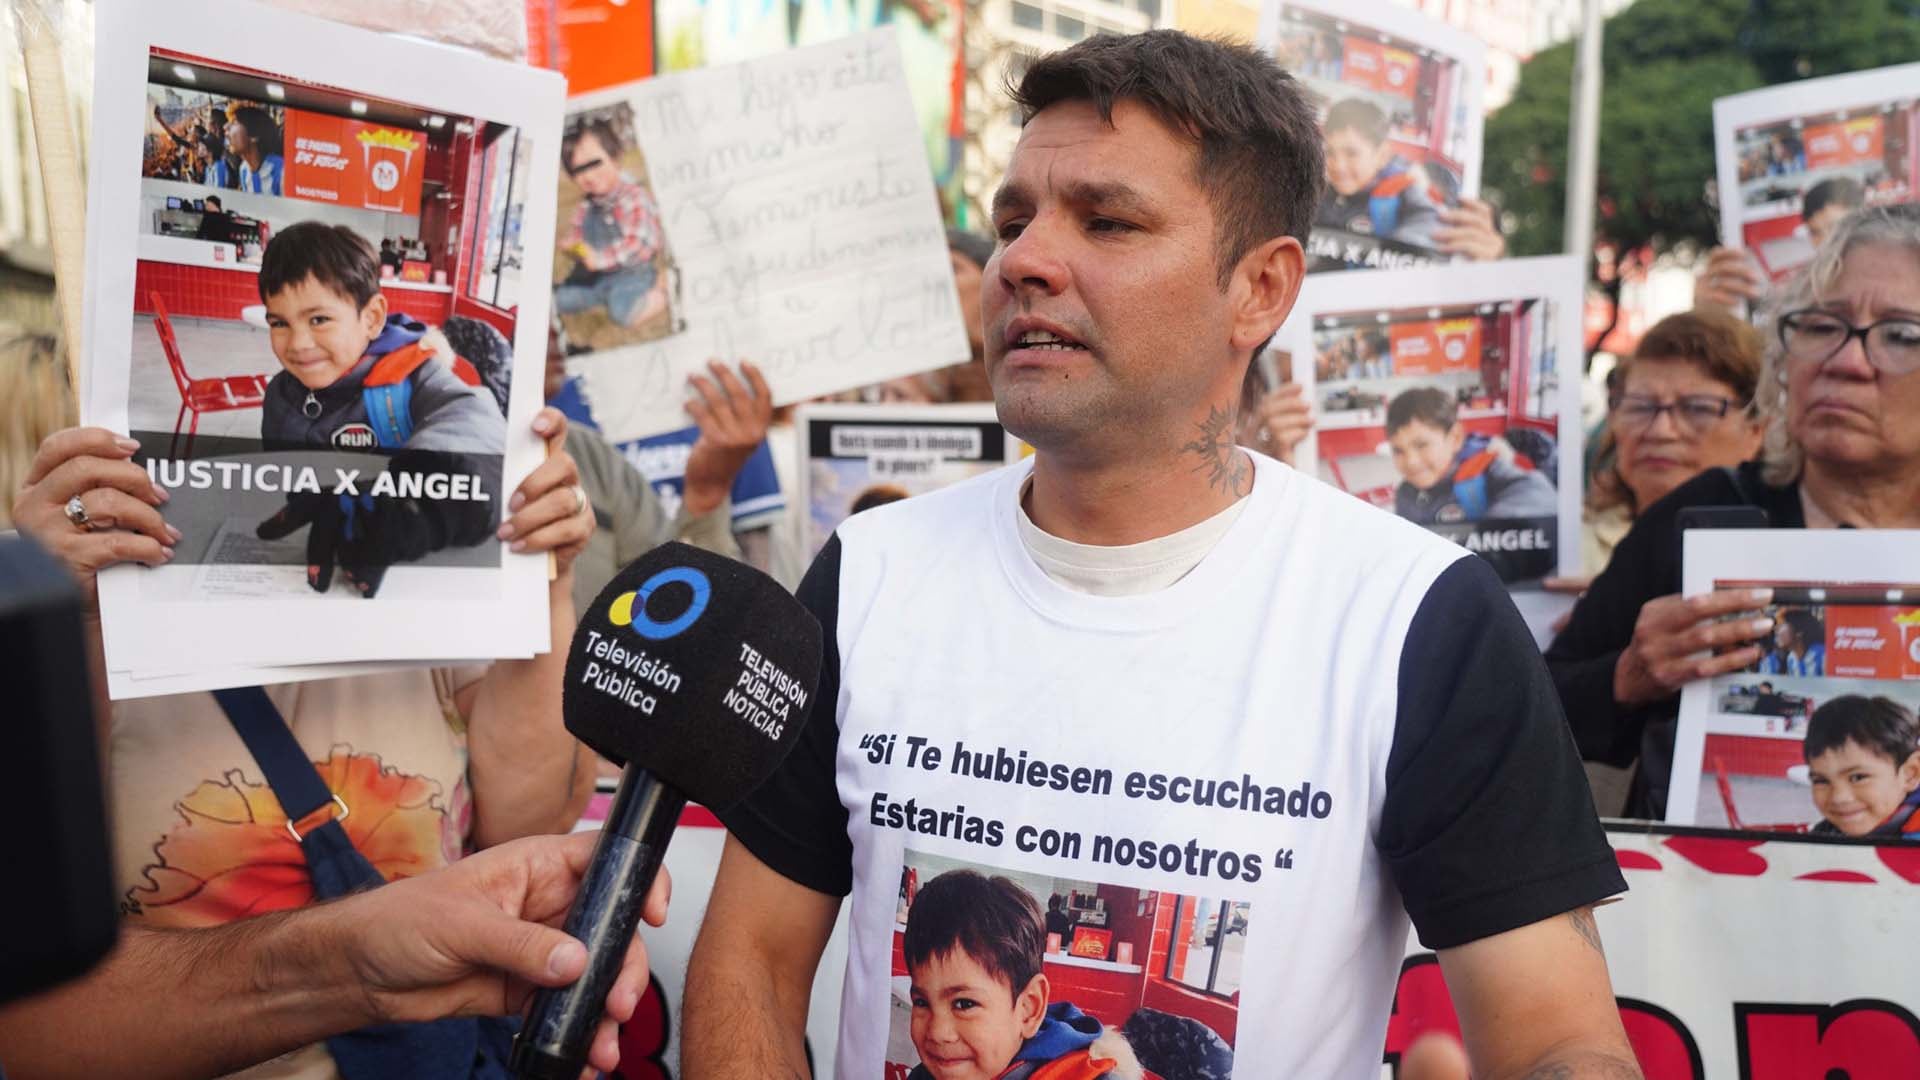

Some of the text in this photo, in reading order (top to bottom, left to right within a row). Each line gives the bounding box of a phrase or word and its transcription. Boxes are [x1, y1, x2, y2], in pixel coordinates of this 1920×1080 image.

[340, 432, 373, 447] RUN
[146, 457, 491, 502] JUSTICIA X ANGEL
[1465, 528, 1550, 552] ANGEL
[582, 661, 657, 716] Pública
[585, 631, 682, 694] Televisión
[738, 643, 808, 710] TELEVISIÓN
[723, 688, 784, 741] NOTICIAS
[737, 670, 790, 722] PÚBLICA
[905, 736, 942, 771] Te
[951, 742, 1113, 796] hubiesen
[1124, 771, 1333, 820] escuchado
[870, 792, 1004, 848] Estarias
[1015, 824, 1083, 860] con
[1092, 833, 1263, 884] nosotros
